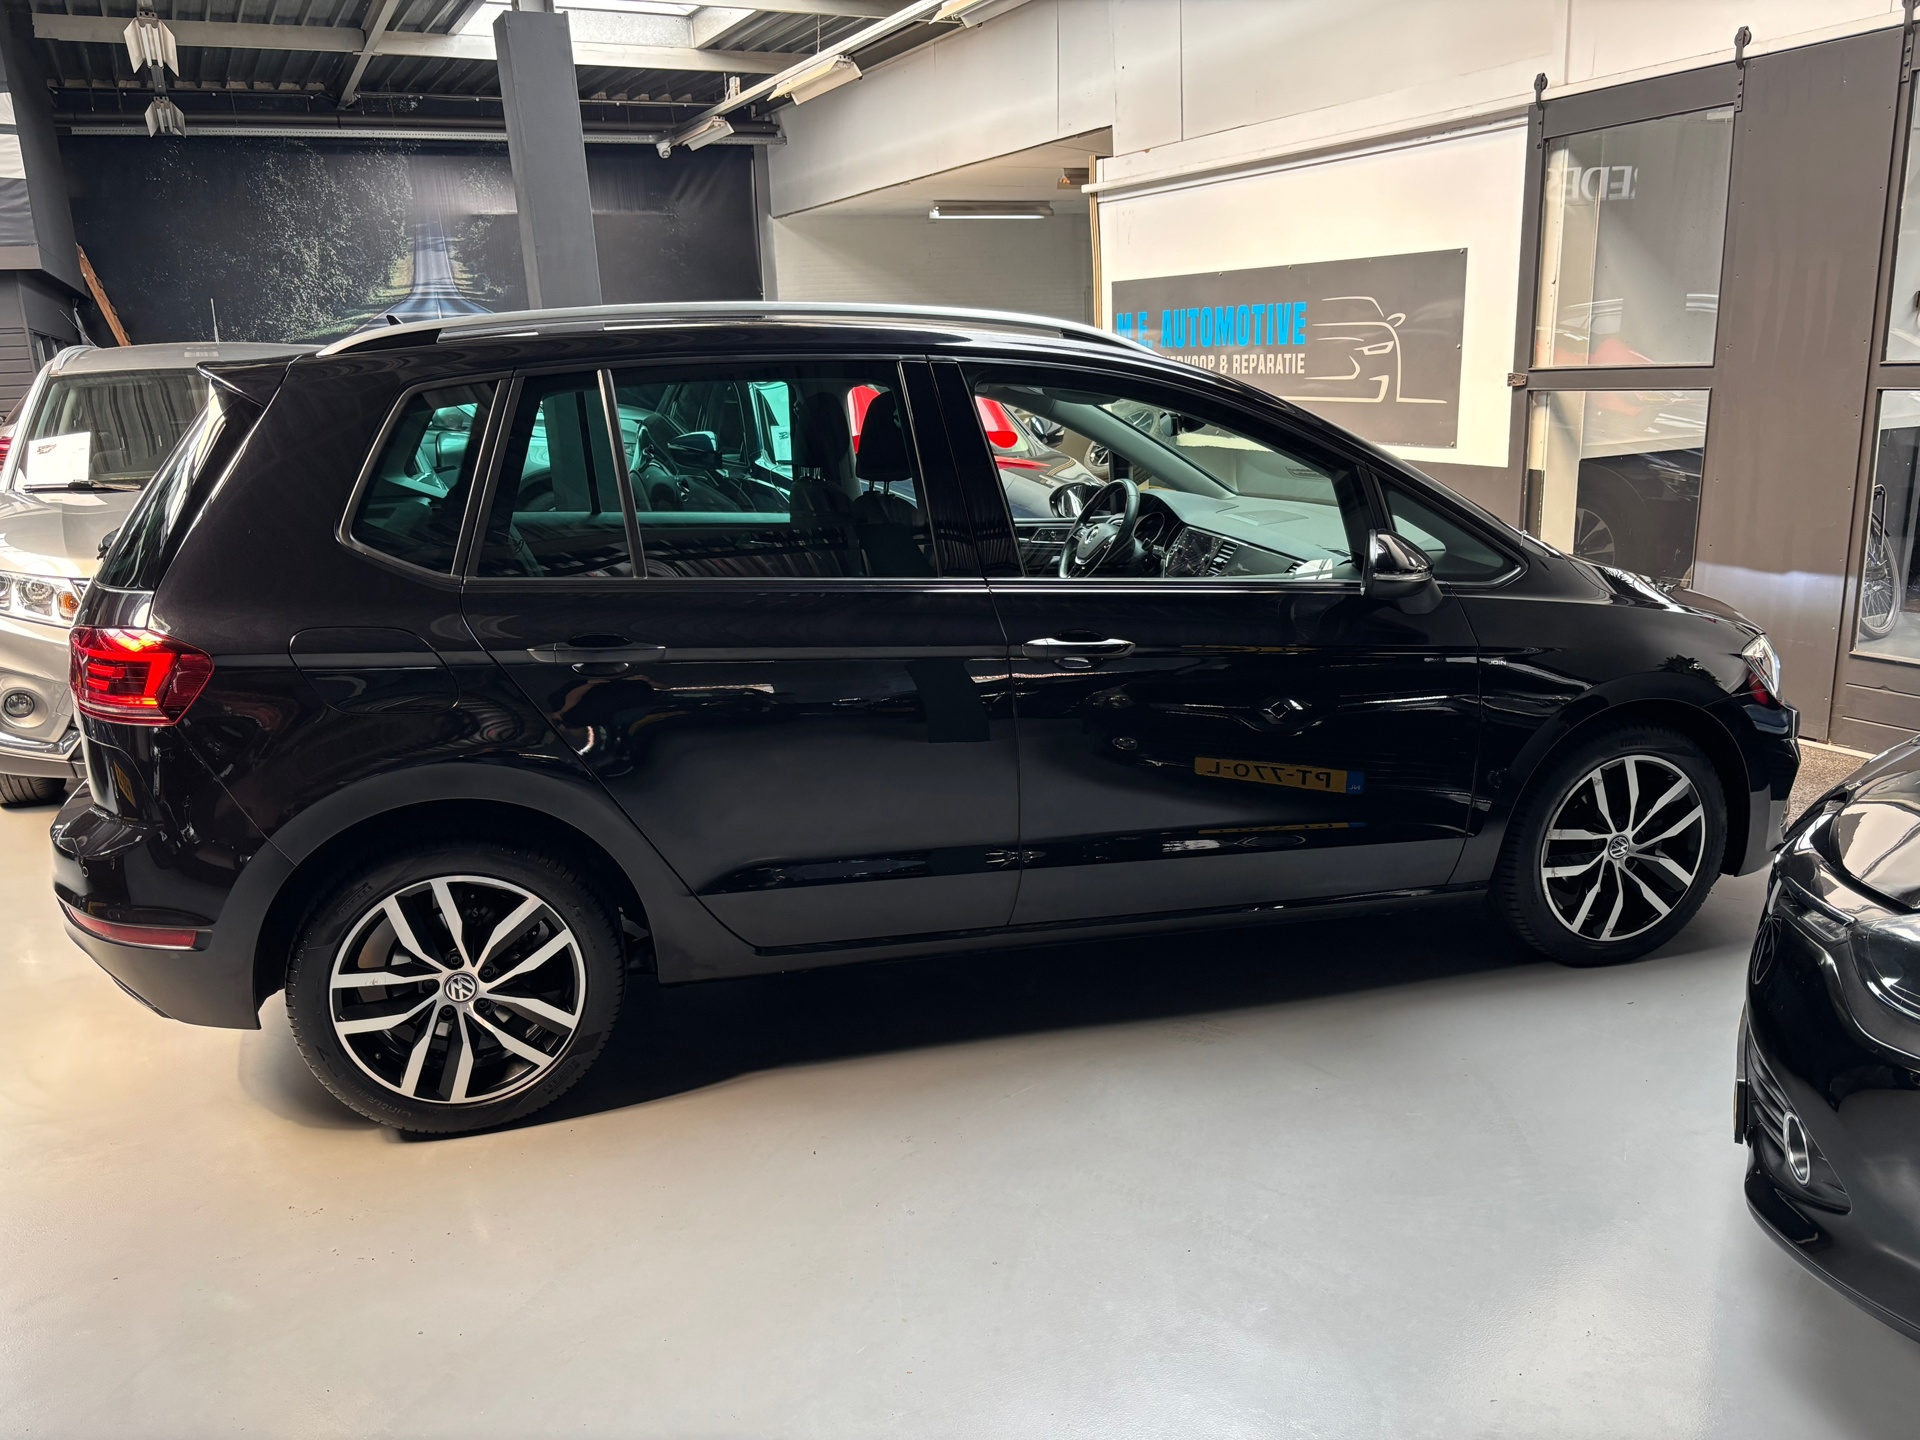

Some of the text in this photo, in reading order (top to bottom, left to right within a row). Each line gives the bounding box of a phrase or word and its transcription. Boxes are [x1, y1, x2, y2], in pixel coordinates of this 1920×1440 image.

[1160, 300, 1307, 349] AUTOMOTIVE
[1219, 354, 1229, 375] &
[1233, 352, 1306, 375] REPARATIE
